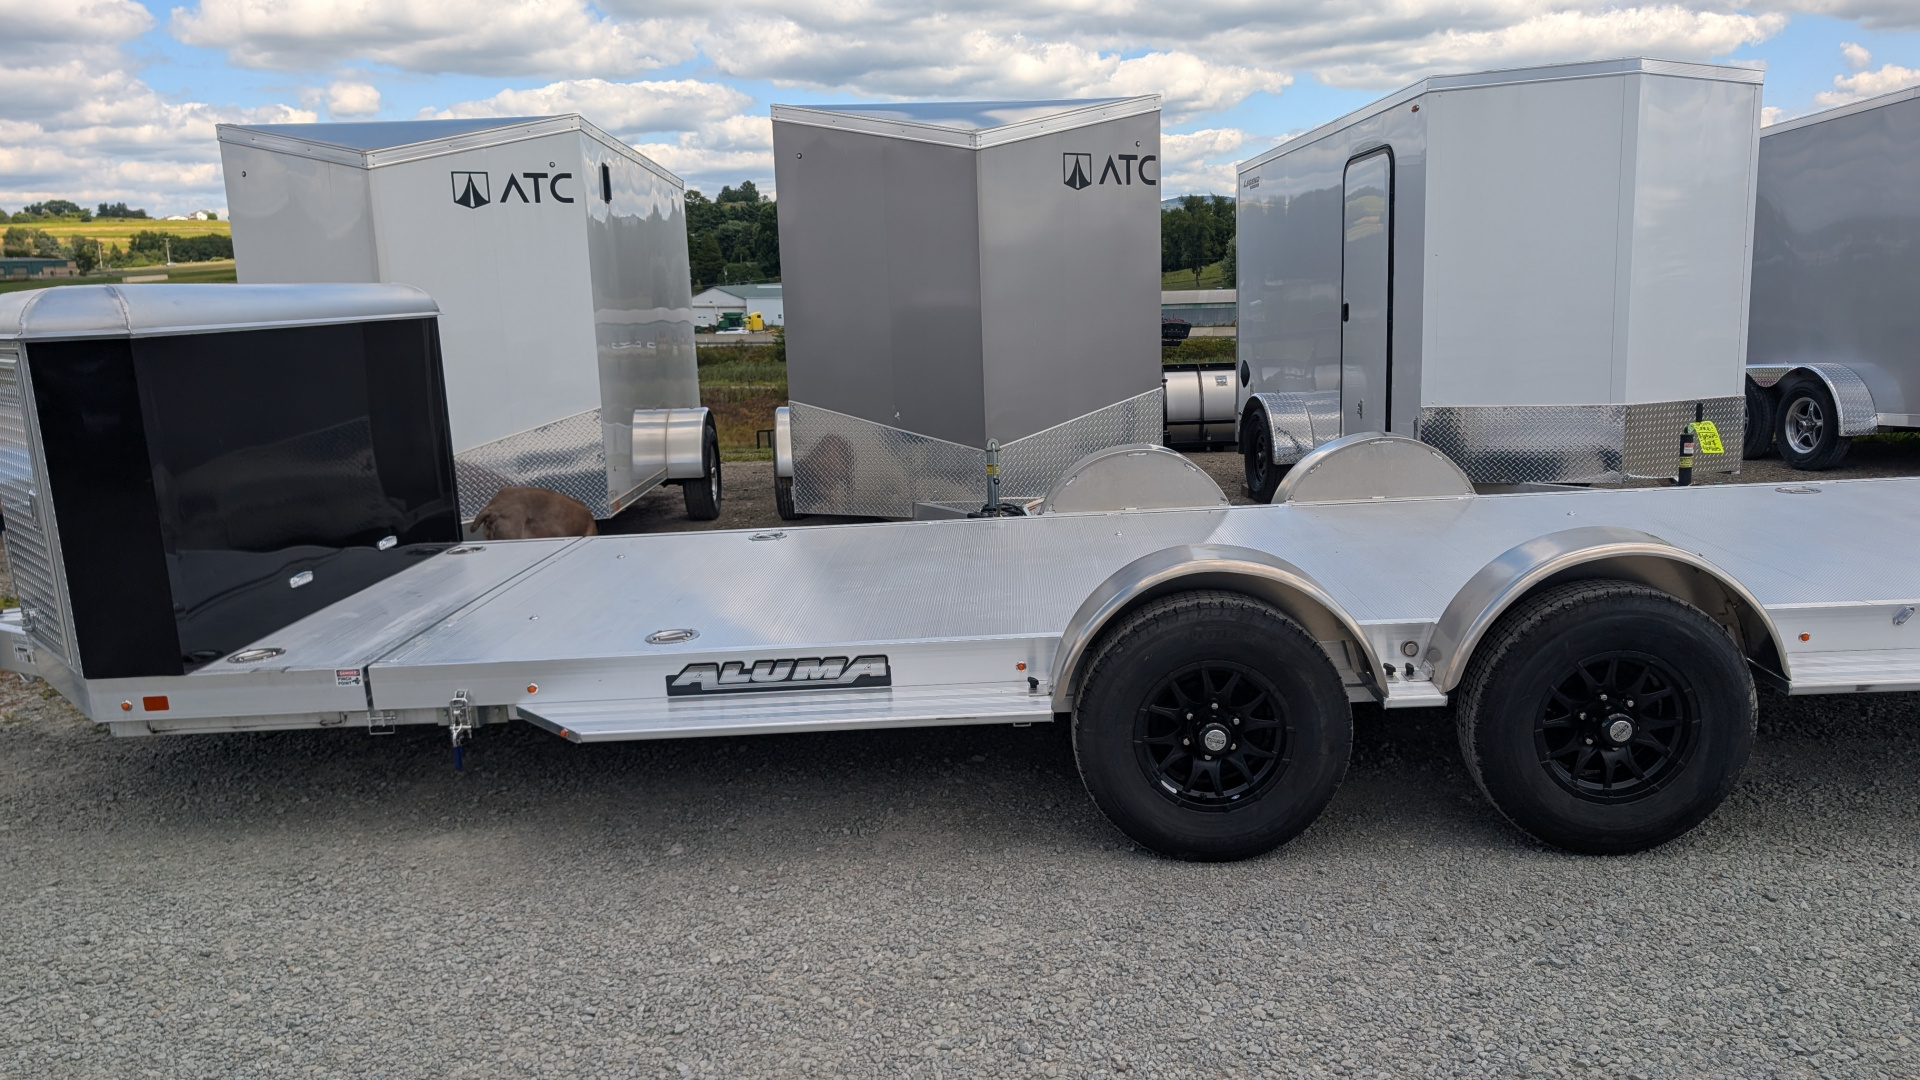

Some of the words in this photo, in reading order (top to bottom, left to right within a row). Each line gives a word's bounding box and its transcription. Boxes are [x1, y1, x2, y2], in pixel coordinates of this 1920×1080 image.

[1099, 154, 1157, 186] ATC
[500, 172, 574, 203] ATC
[670, 655, 888, 691] ALUMA
